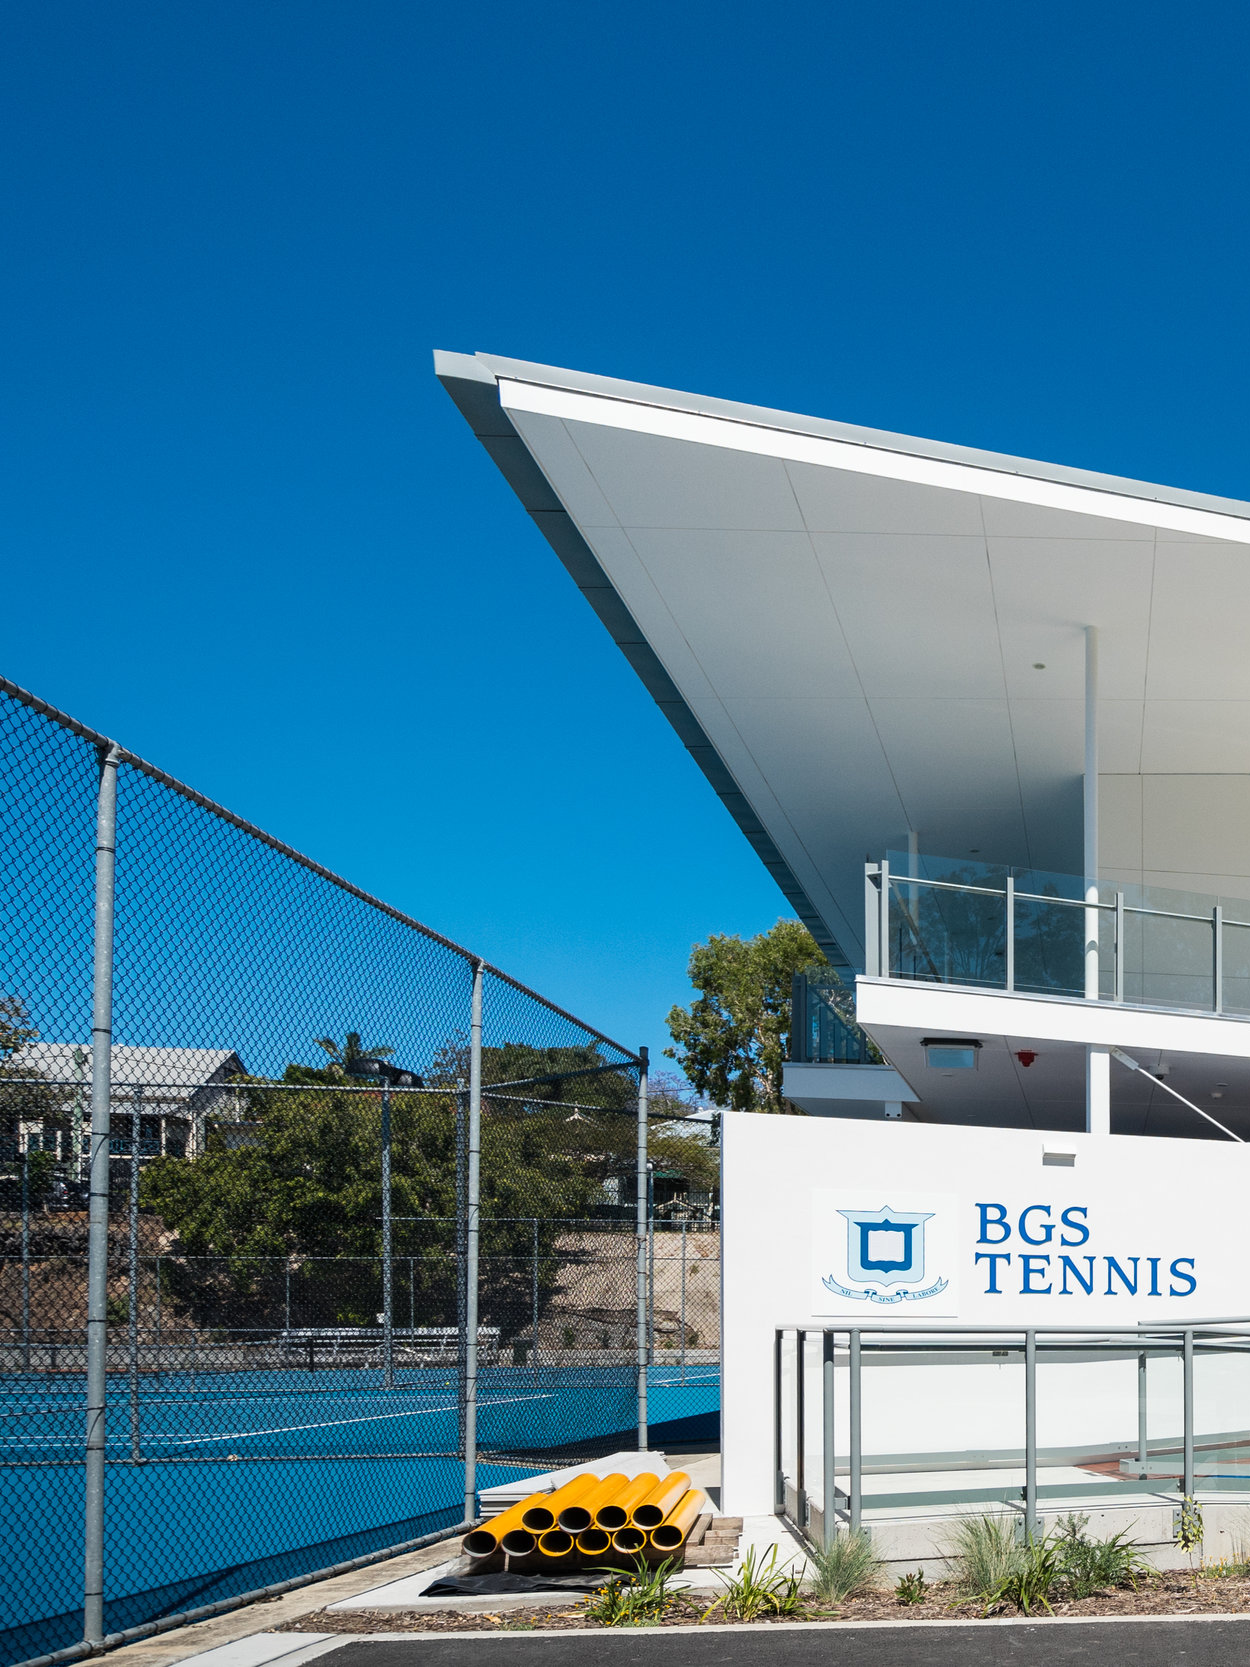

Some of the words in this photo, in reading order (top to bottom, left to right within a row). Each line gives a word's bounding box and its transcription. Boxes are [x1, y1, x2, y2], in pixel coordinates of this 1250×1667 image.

[975, 1202, 1090, 1247] BGS
[840, 1288, 853, 1297] NIL
[974, 1251, 1197, 1297] TENNIS
